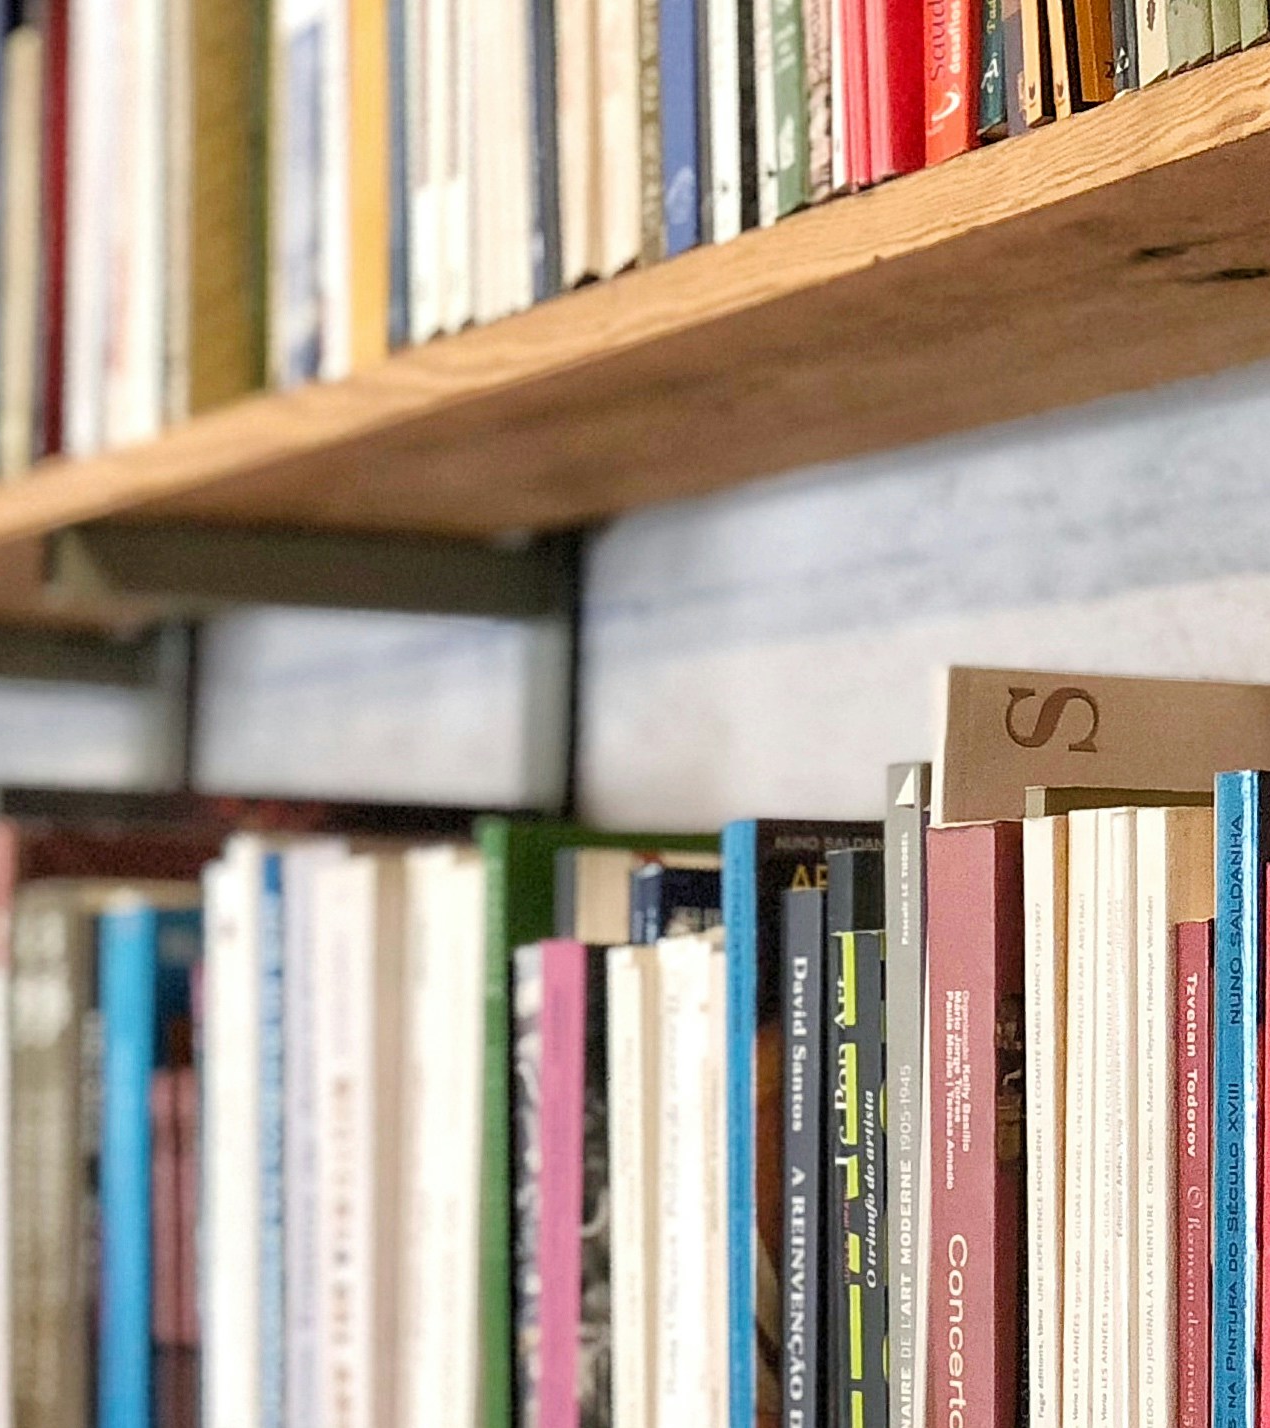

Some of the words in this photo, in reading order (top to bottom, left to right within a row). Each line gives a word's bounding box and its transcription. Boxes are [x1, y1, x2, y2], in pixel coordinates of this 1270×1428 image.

[1006, 687, 1099, 752] S
[1230, 815, 1243, 948] SALDANHA
[792, 955, 808, 1036] David
[1186, 971, 1199, 1057] Tzvetan
[1229, 957, 1242, 1025] NUNO
[791, 1043, 807, 1133] Santos
[899, 1064, 911, 1151] 1905-1945
[1186, 1067, 1199, 1157] Todorov
[1227, 1083, 1240, 1134] XVIII
[863, 1089, 875, 1161] artista
[790, 1166, 806, 1187] A
[865, 1163, 876, 1189] do
[1225, 1142, 1239, 1233] SÉCULO
[864, 1193, 878, 1265] triunfo
[900, 1159, 911, 1265] MODERNE
[1145, 1204, 1155, 1267] PEINTURE
[1146, 1271, 1154, 1286] LA
[1228, 1242, 1238, 1273] DO
[787, 1195, 806, 1400] REINVENÇÃO
[900, 1272, 911, 1330] L'ART
[1225, 1280, 1238, 1372] PINTURA
[900, 1337, 911, 1359] DE
[1145, 1305, 1155, 1363] JOURNAL
[1072, 1368, 1080, 1389] LES
[1146, 1366, 1154, 1385] DU
[1227, 1382, 1237, 1409] NA
